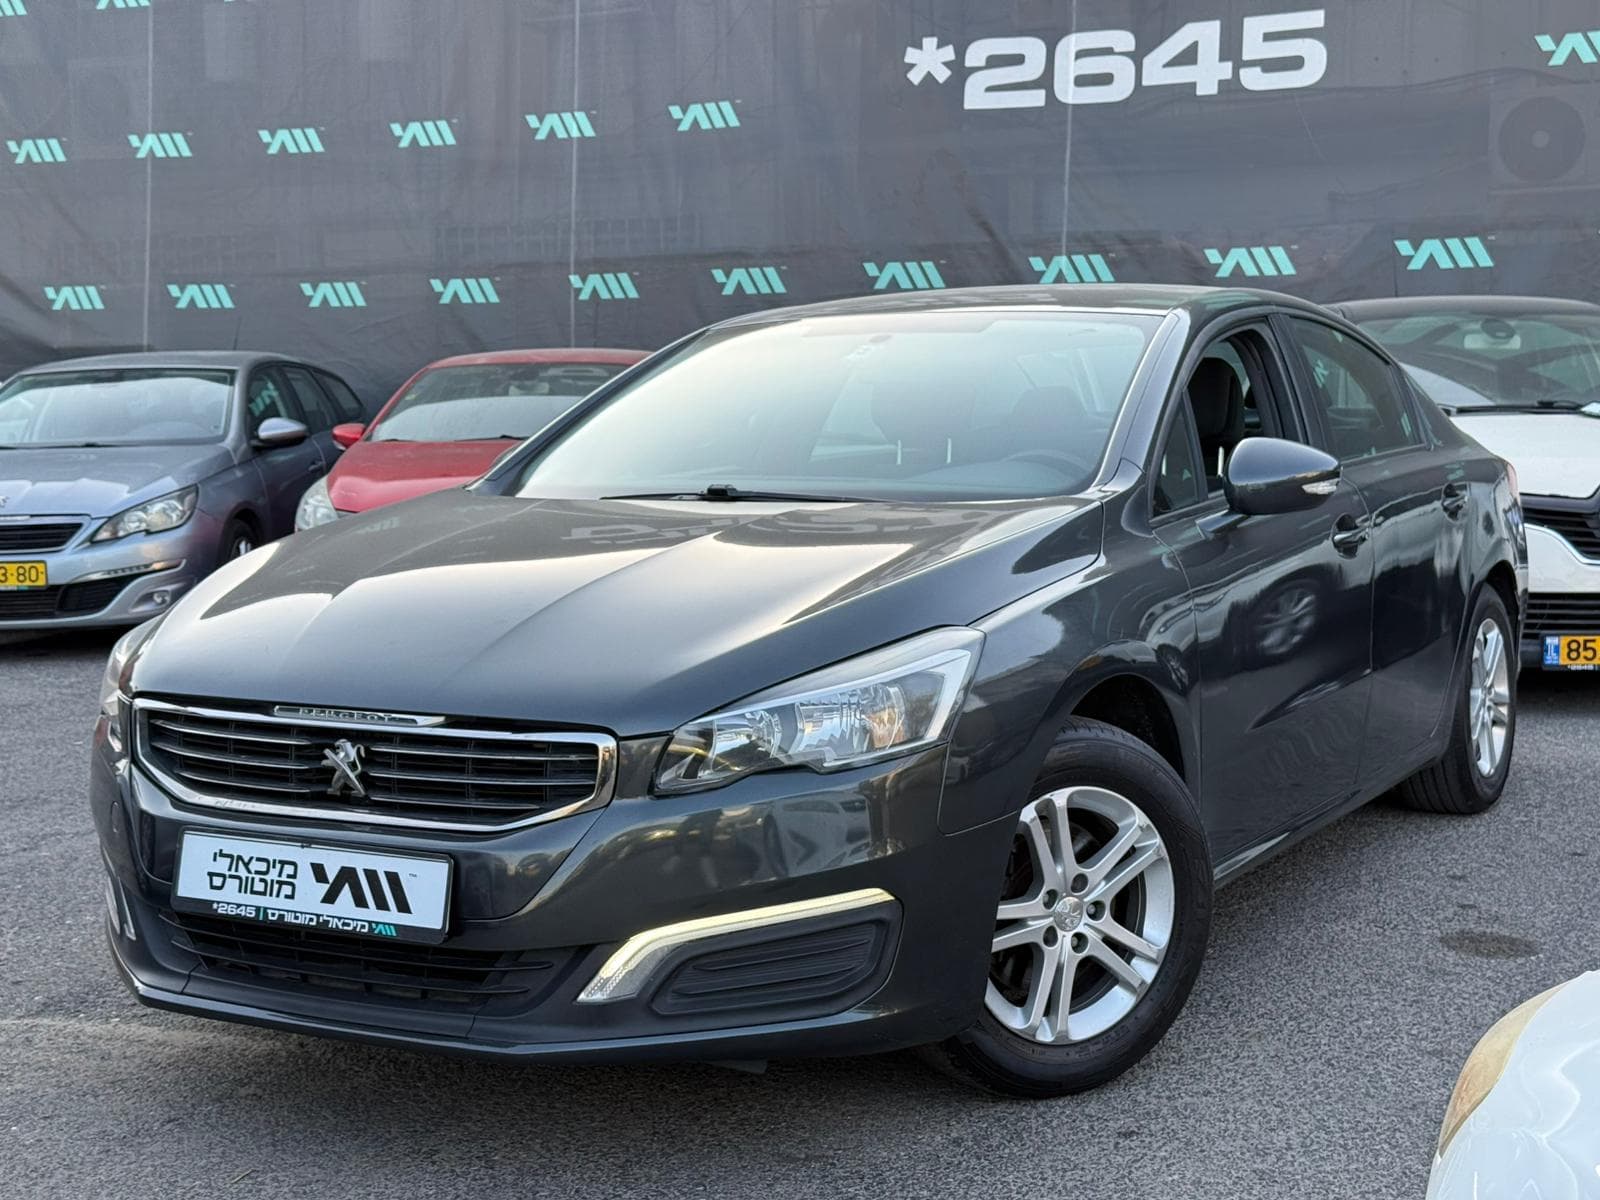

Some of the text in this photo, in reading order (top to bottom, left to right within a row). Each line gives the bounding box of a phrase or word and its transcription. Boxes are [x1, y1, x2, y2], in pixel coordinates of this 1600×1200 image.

[212, 848, 299, 880] מיכאלי
[206, 871, 296, 900] מוטורס
[266, 908, 317, 926] מוטורס
[319, 914, 369, 933] מיכאלי
